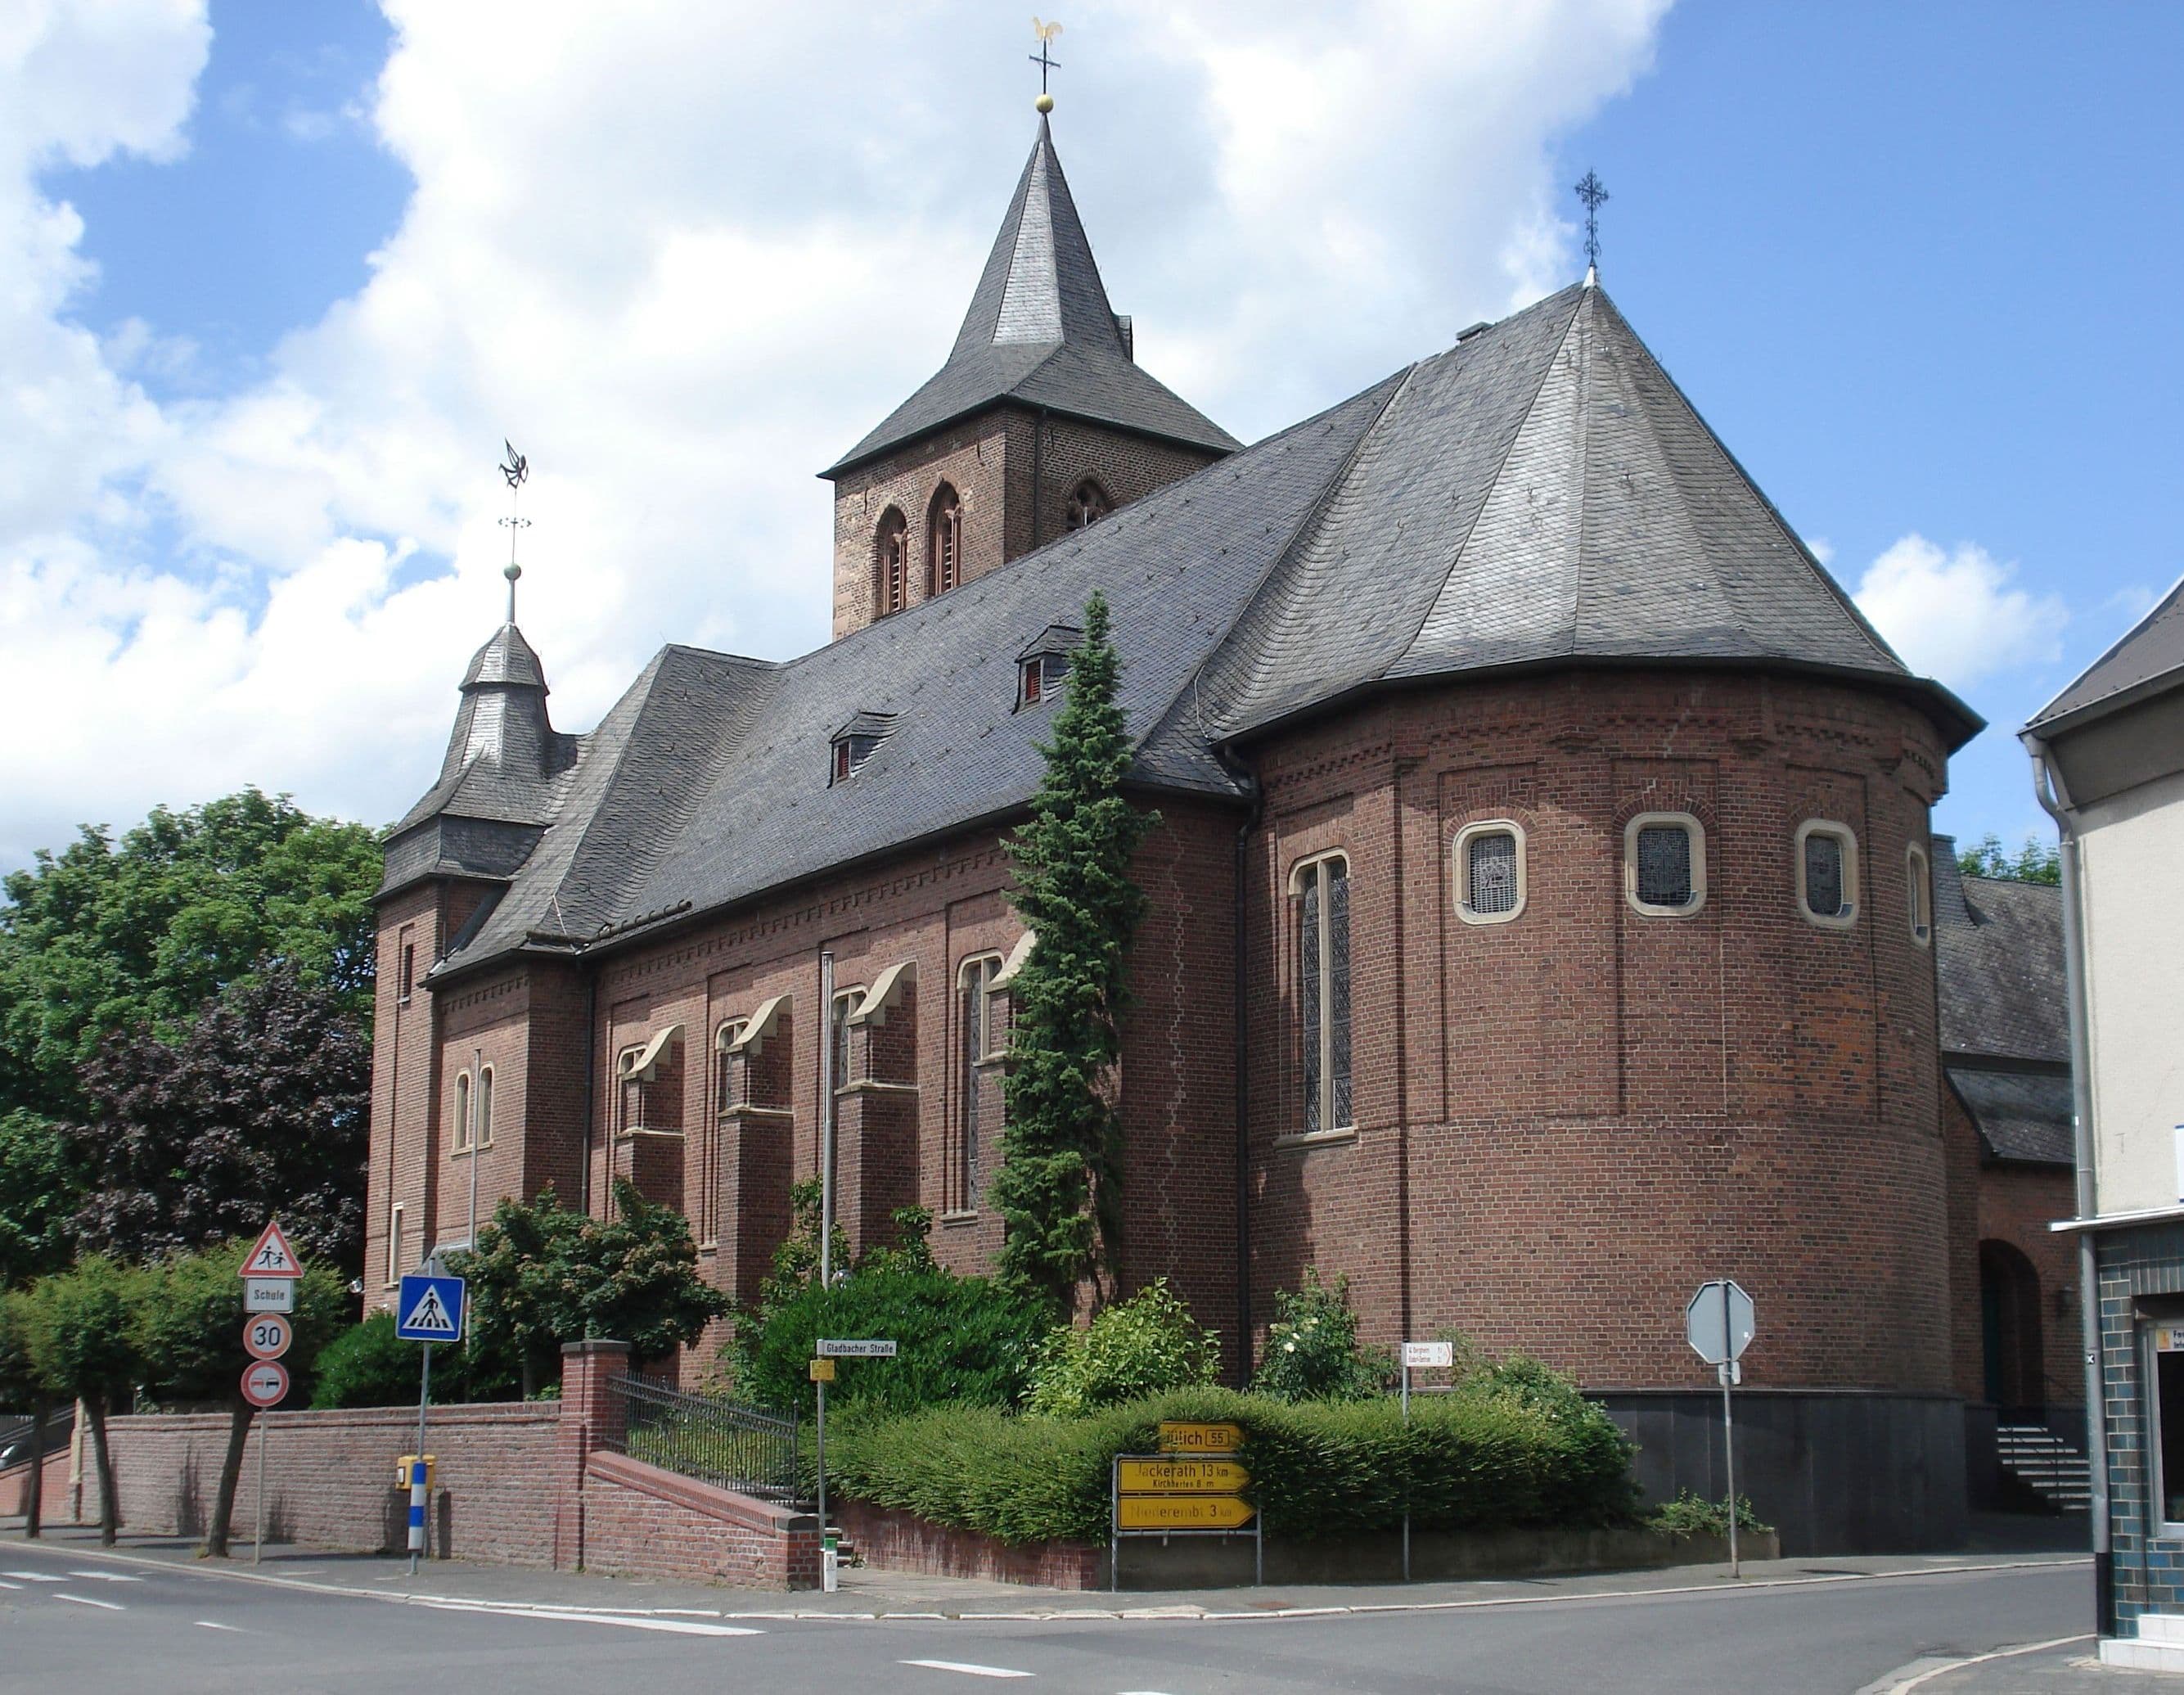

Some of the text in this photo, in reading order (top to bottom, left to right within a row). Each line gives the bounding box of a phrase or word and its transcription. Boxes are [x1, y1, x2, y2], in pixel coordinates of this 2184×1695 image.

[254, 1289, 285, 1301] Schule
[254, 1326, 281, 1346] 30
[826, 1343, 894, 1353] Gladbacher Straße
[1211, 1432, 1223, 1444] 55
[1137, 1463, 1229, 1477] Jackerath 13 km
[1210, 1504, 1217, 1517] 3
